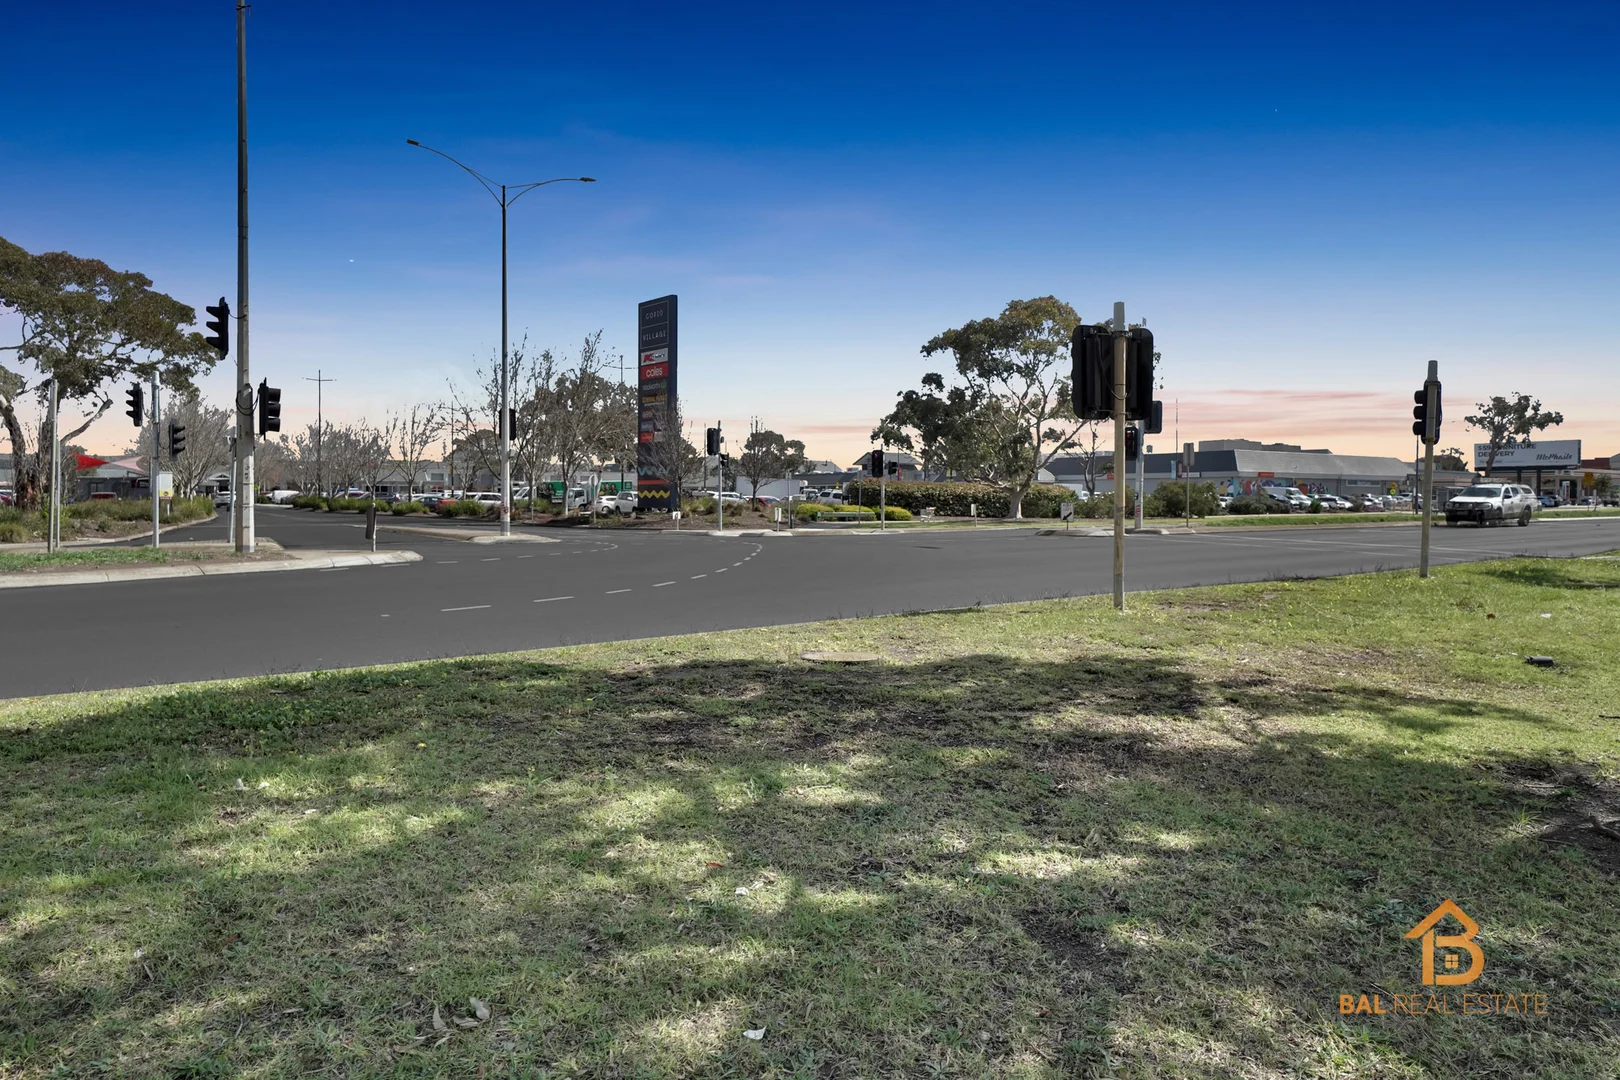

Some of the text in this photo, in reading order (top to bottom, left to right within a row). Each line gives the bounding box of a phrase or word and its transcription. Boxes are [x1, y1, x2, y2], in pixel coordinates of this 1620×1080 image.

[643, 330, 666, 341] VILLAGE
[646, 367, 663, 378] coles
[1536, 453, 1573, 461] McPhails
